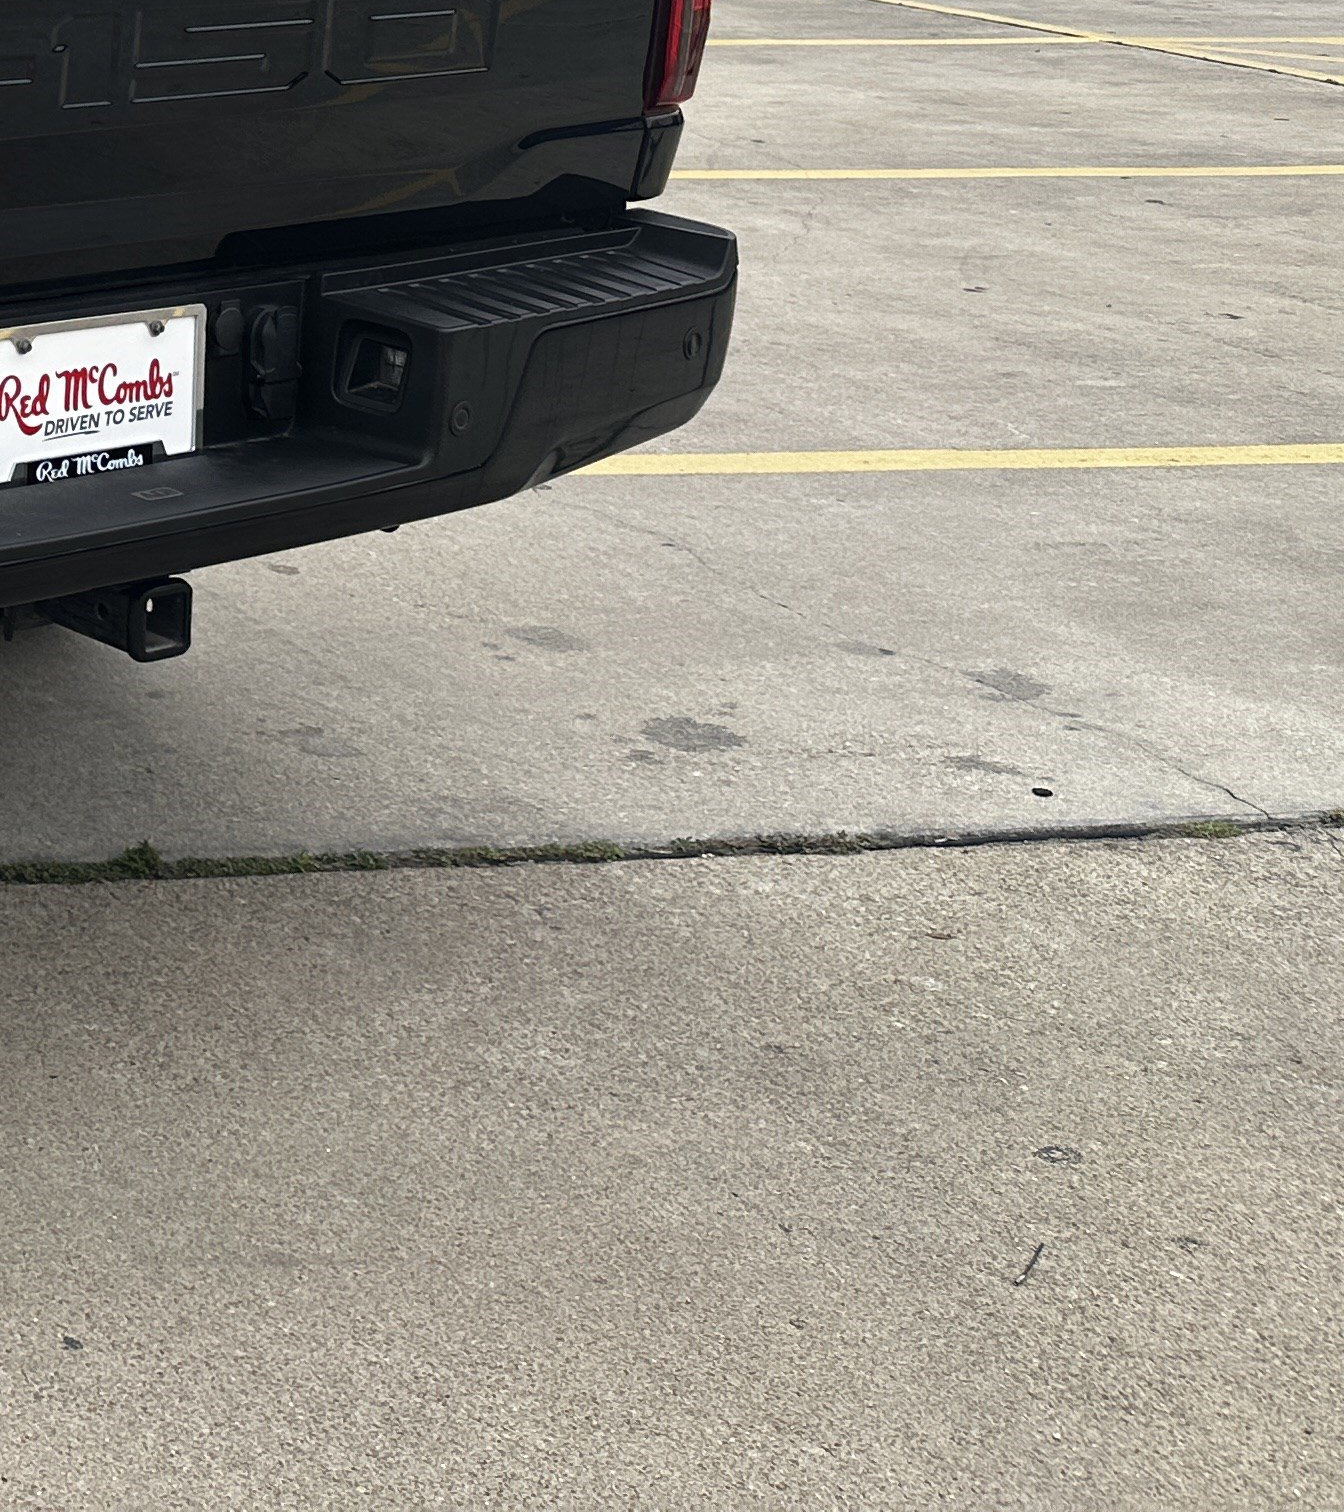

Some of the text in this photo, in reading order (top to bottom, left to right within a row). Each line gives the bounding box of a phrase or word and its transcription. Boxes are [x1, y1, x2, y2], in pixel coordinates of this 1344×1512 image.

[55, 358, 174, 412] McCombs
[44, 401, 173, 436] DRIVEN TO SERVE
[36, 449, 144, 482] Red McCombs
